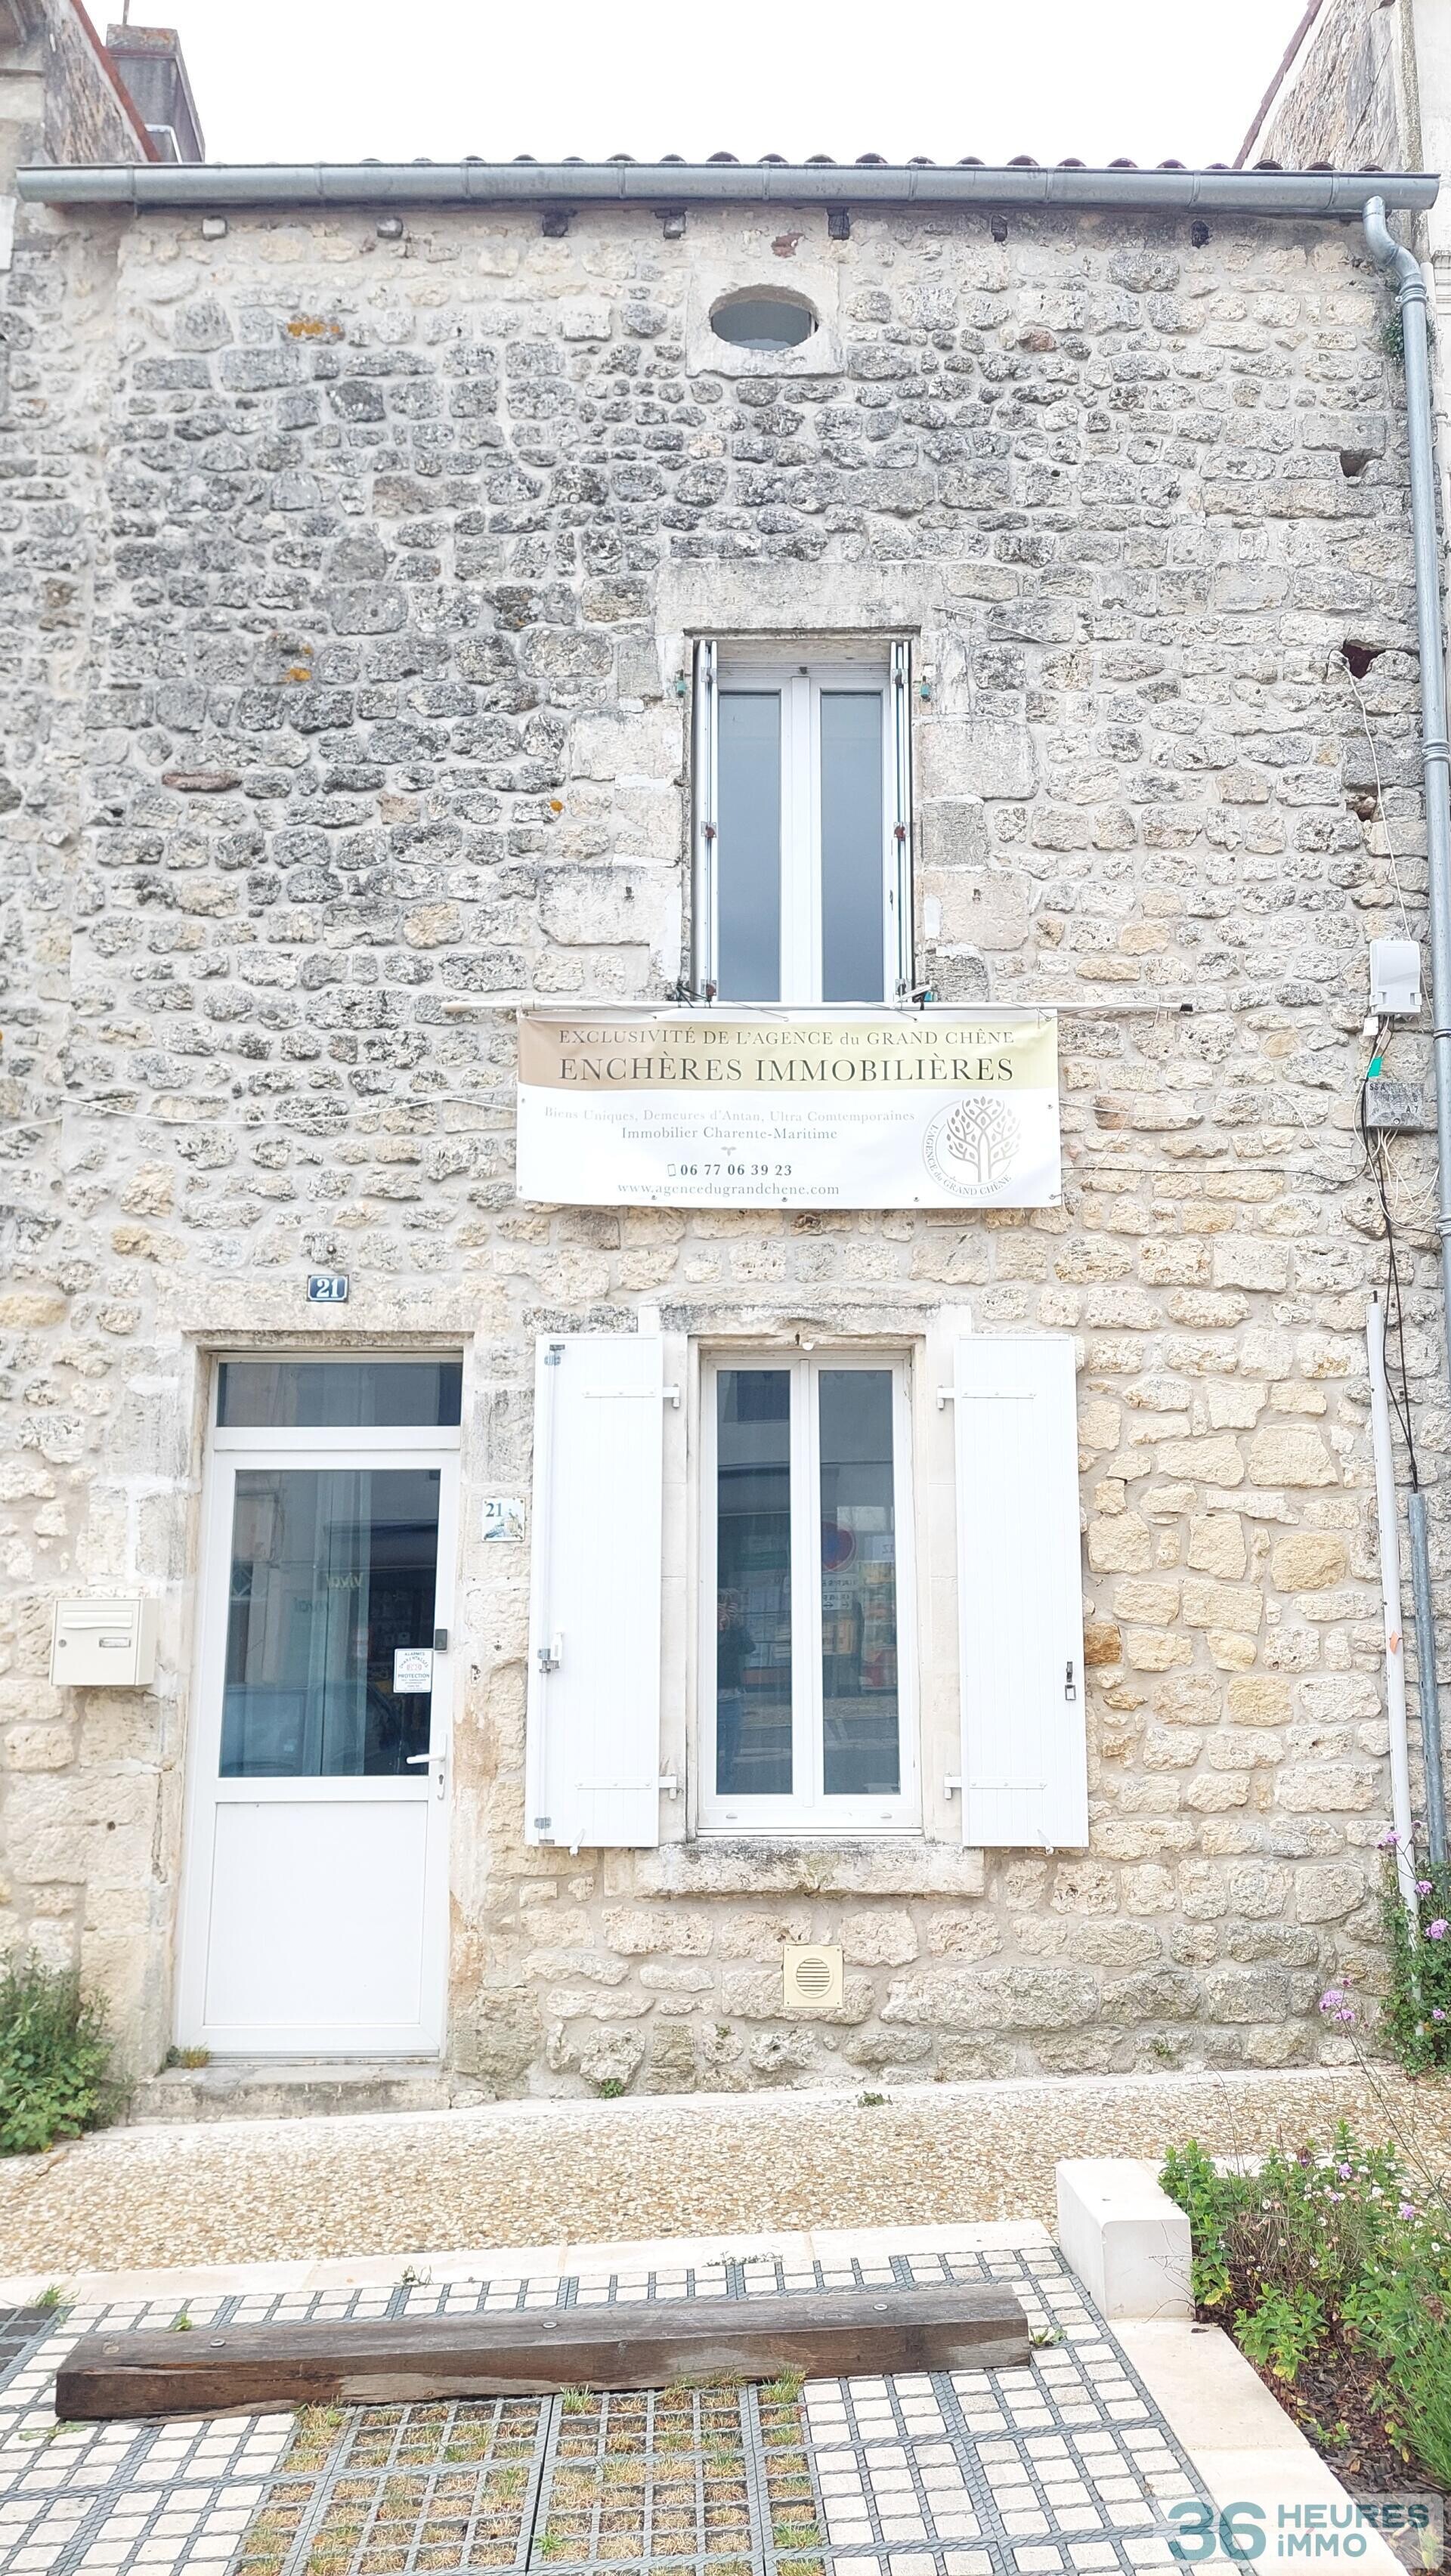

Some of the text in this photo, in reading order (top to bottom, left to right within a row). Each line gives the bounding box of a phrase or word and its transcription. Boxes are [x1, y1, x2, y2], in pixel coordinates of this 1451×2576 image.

[559, 1027, 695, 1044] EXCLUSIVITÉ
[704, 1031, 729, 1044] DE
[840, 1031, 859, 1045] du
[867, 1031, 937, 1045] GRAND
[945, 1028, 1014, 1044] CHÊNE
[559, 1051, 1013, 1081] ENCHÈRES IMMOBILIÈRES
[545, 1106, 578, 1119] Biens
[583, 1109, 638, 1124] Uniques,
[643, 1109, 705, 1121] Demeures
[770, 1111, 802, 1122] Ultra
[621, 1126, 838, 1140] Immobilier Charente-Maritime
[680, 1164, 792, 1176] 06 77 06 39 23
[617, 1183, 840, 1198] www.agencedugrandchene.com
[943, 1179, 977, 1195] GRAND
[316, 1278, 339, 1297] 21
[485, 1502, 503, 1517] 21
